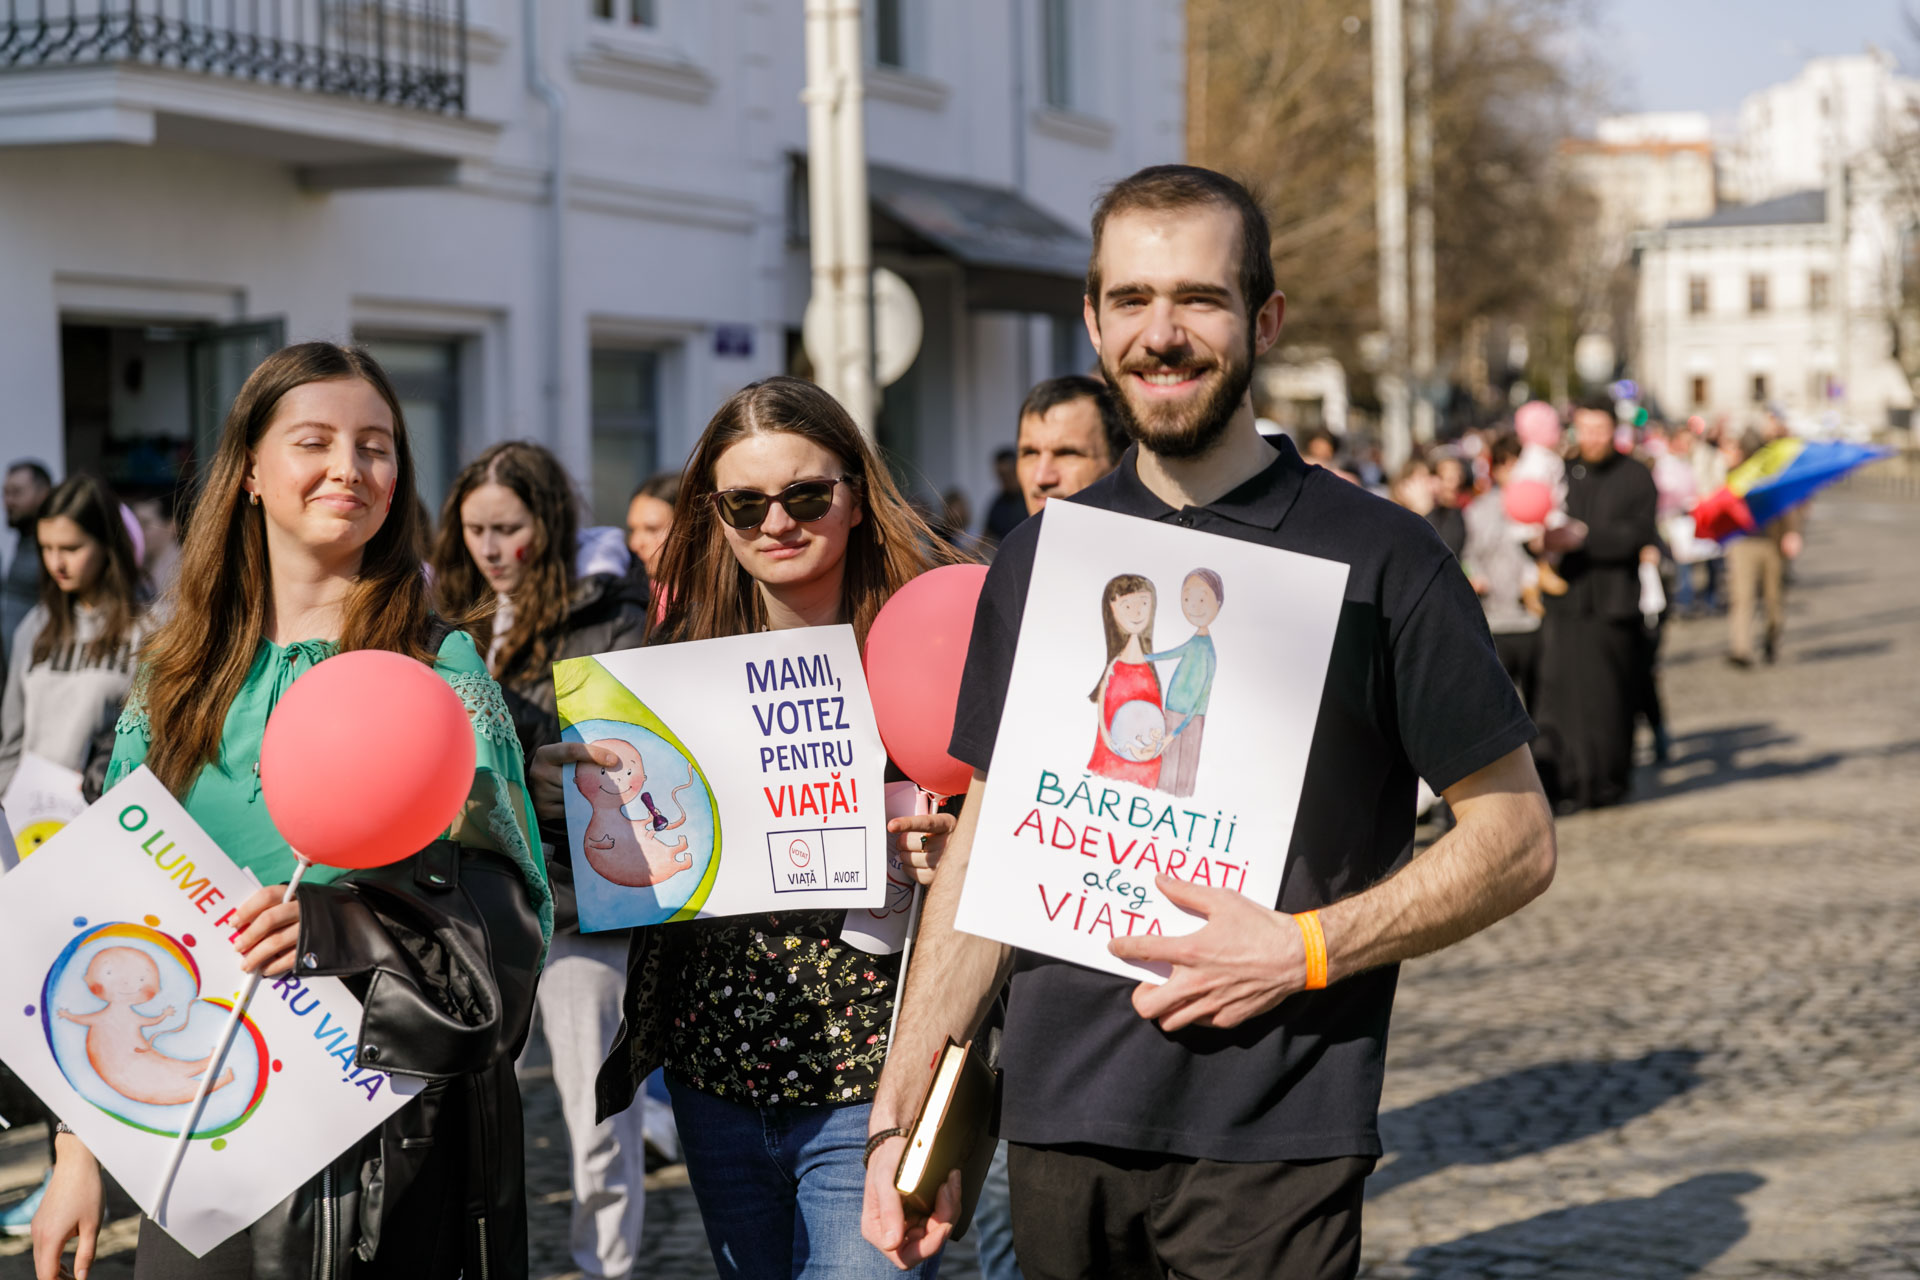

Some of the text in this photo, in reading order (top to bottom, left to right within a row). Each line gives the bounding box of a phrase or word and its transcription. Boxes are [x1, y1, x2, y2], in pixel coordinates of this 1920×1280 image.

[745, 653, 842, 694] MAMI,
[752, 696, 850, 736] VOTEZ
[760, 739, 854, 773] PENTRU
[764, 771, 859, 823] VIAȚĂ!
[118, 804, 149, 832] O
[141, 829, 225, 914] LUME
[791, 847, 809, 860] VOTAT
[787, 869, 817, 887] VIAȚĂ
[833, 871, 860, 883] AVORT
[1082, 868, 1153, 910] aleg
